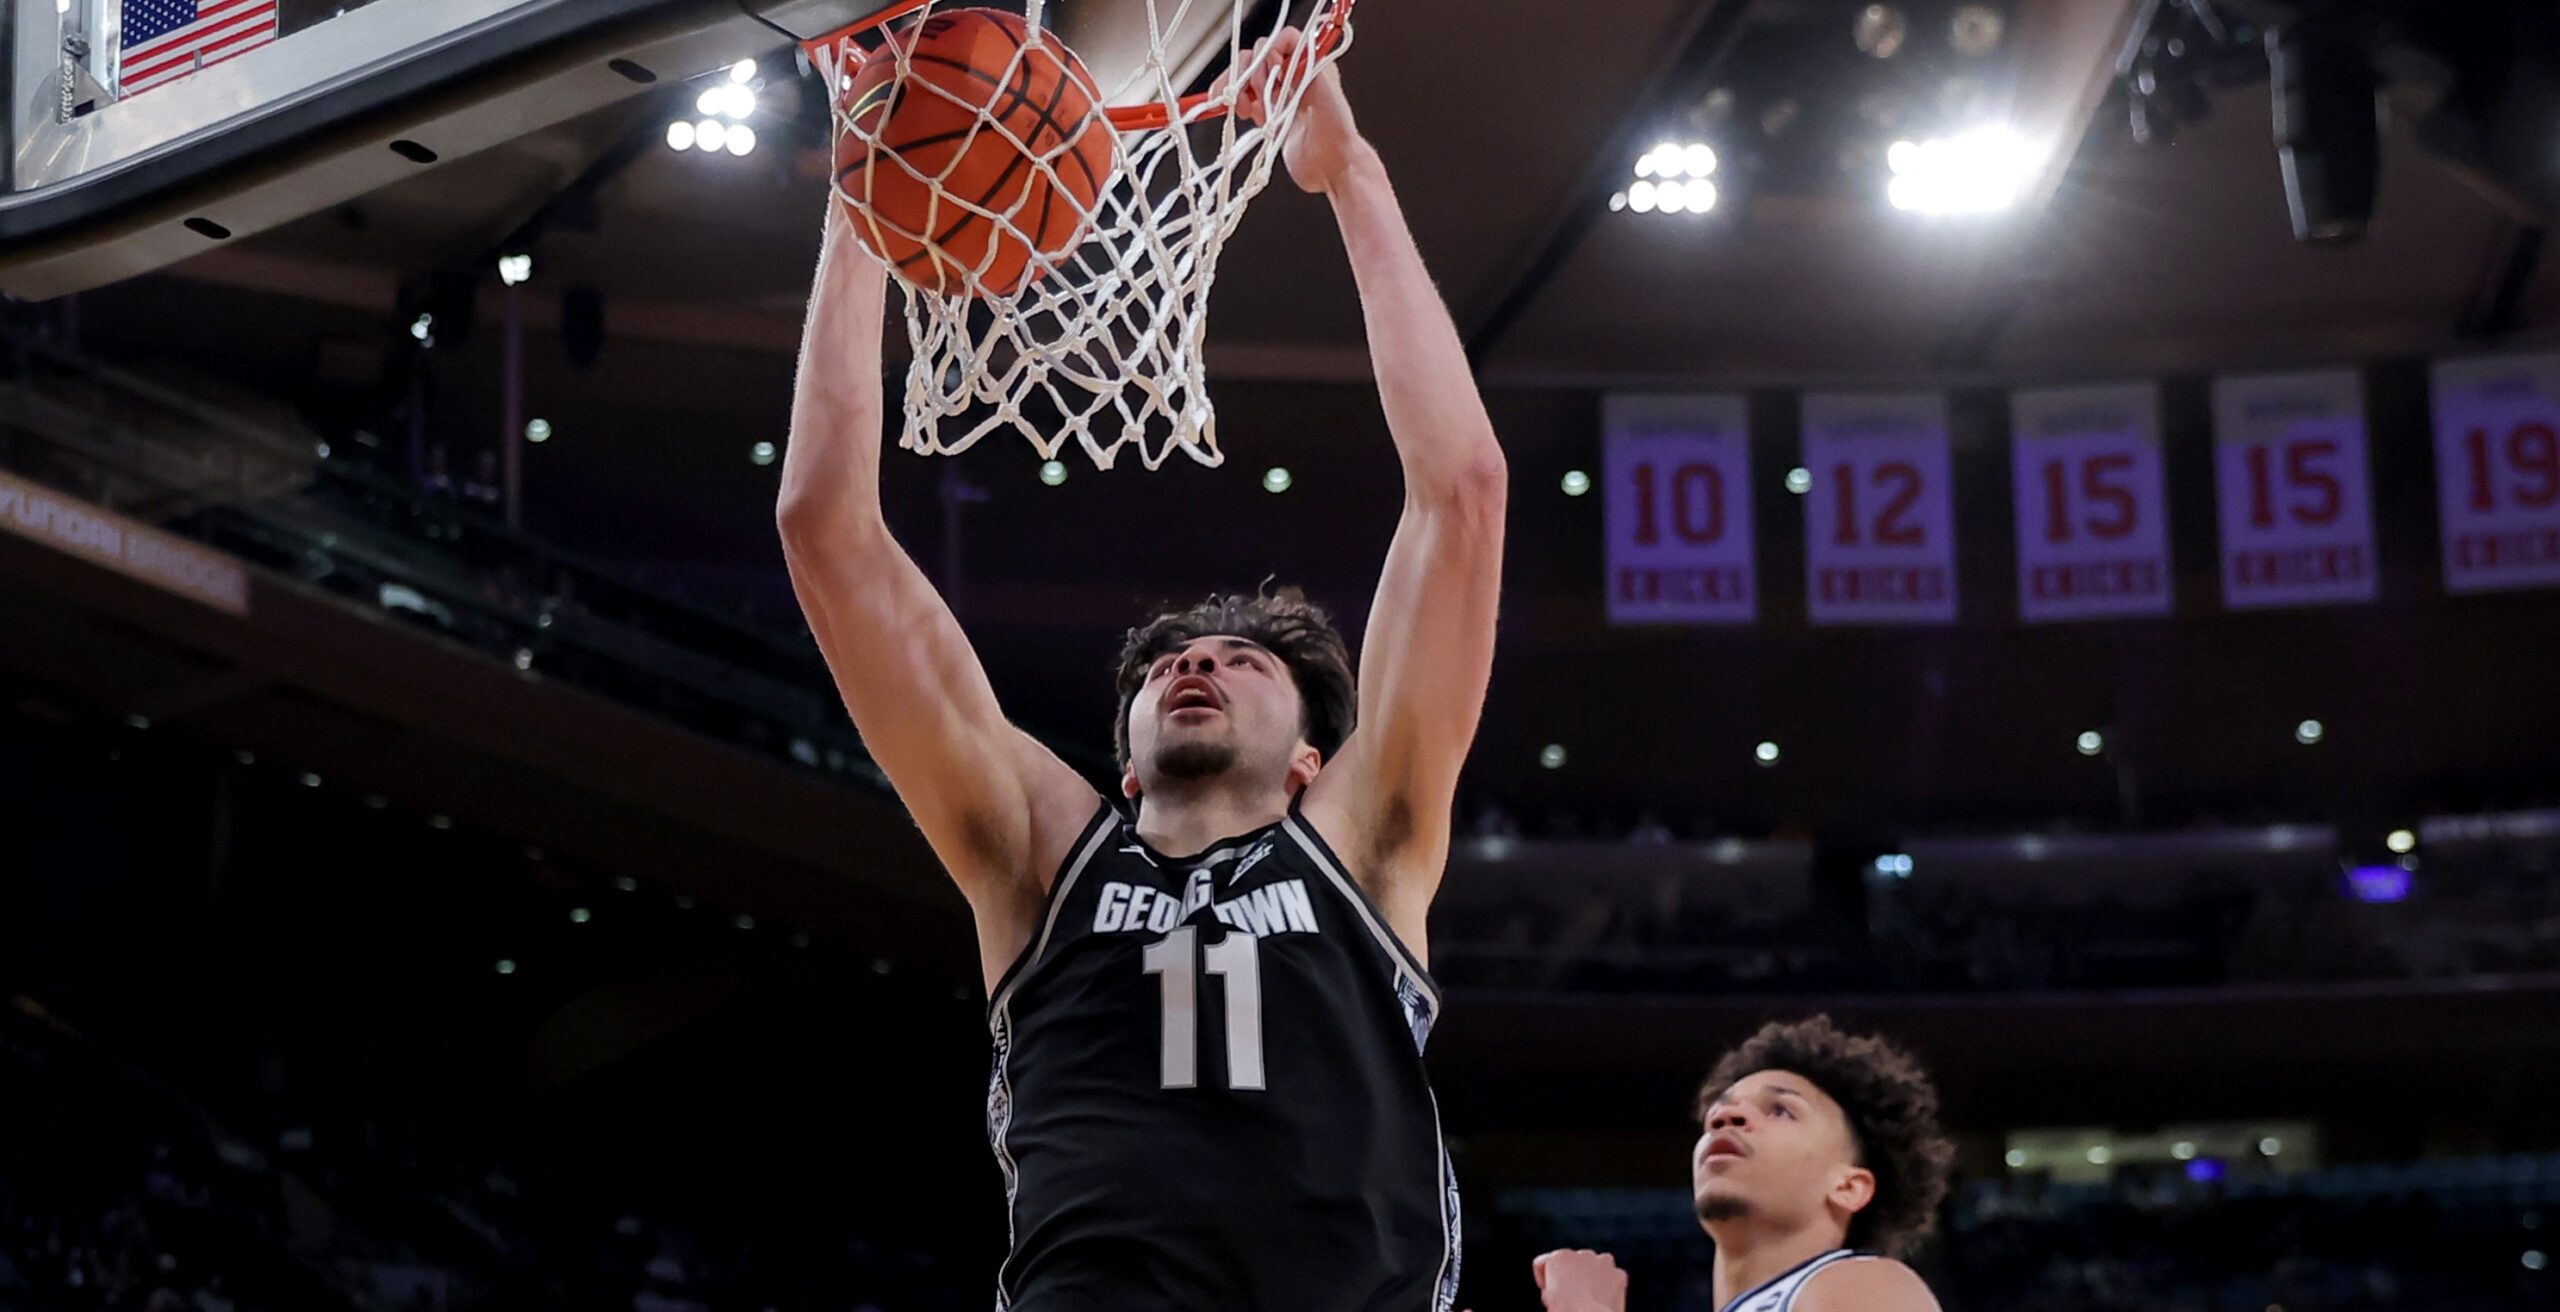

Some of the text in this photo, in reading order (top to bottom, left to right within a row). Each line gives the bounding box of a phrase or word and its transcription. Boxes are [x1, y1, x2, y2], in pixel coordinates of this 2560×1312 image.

[1633, 463, 1725, 546] 10
[1832, 463, 1926, 546] 12
[2042, 453, 2138, 544] 15
[2246, 441, 2341, 530] 15
[2465, 423, 2560, 513] 19
[1093, 868, 1319, 938] GEOGOWN
[1142, 925, 1266, 1091] 11
